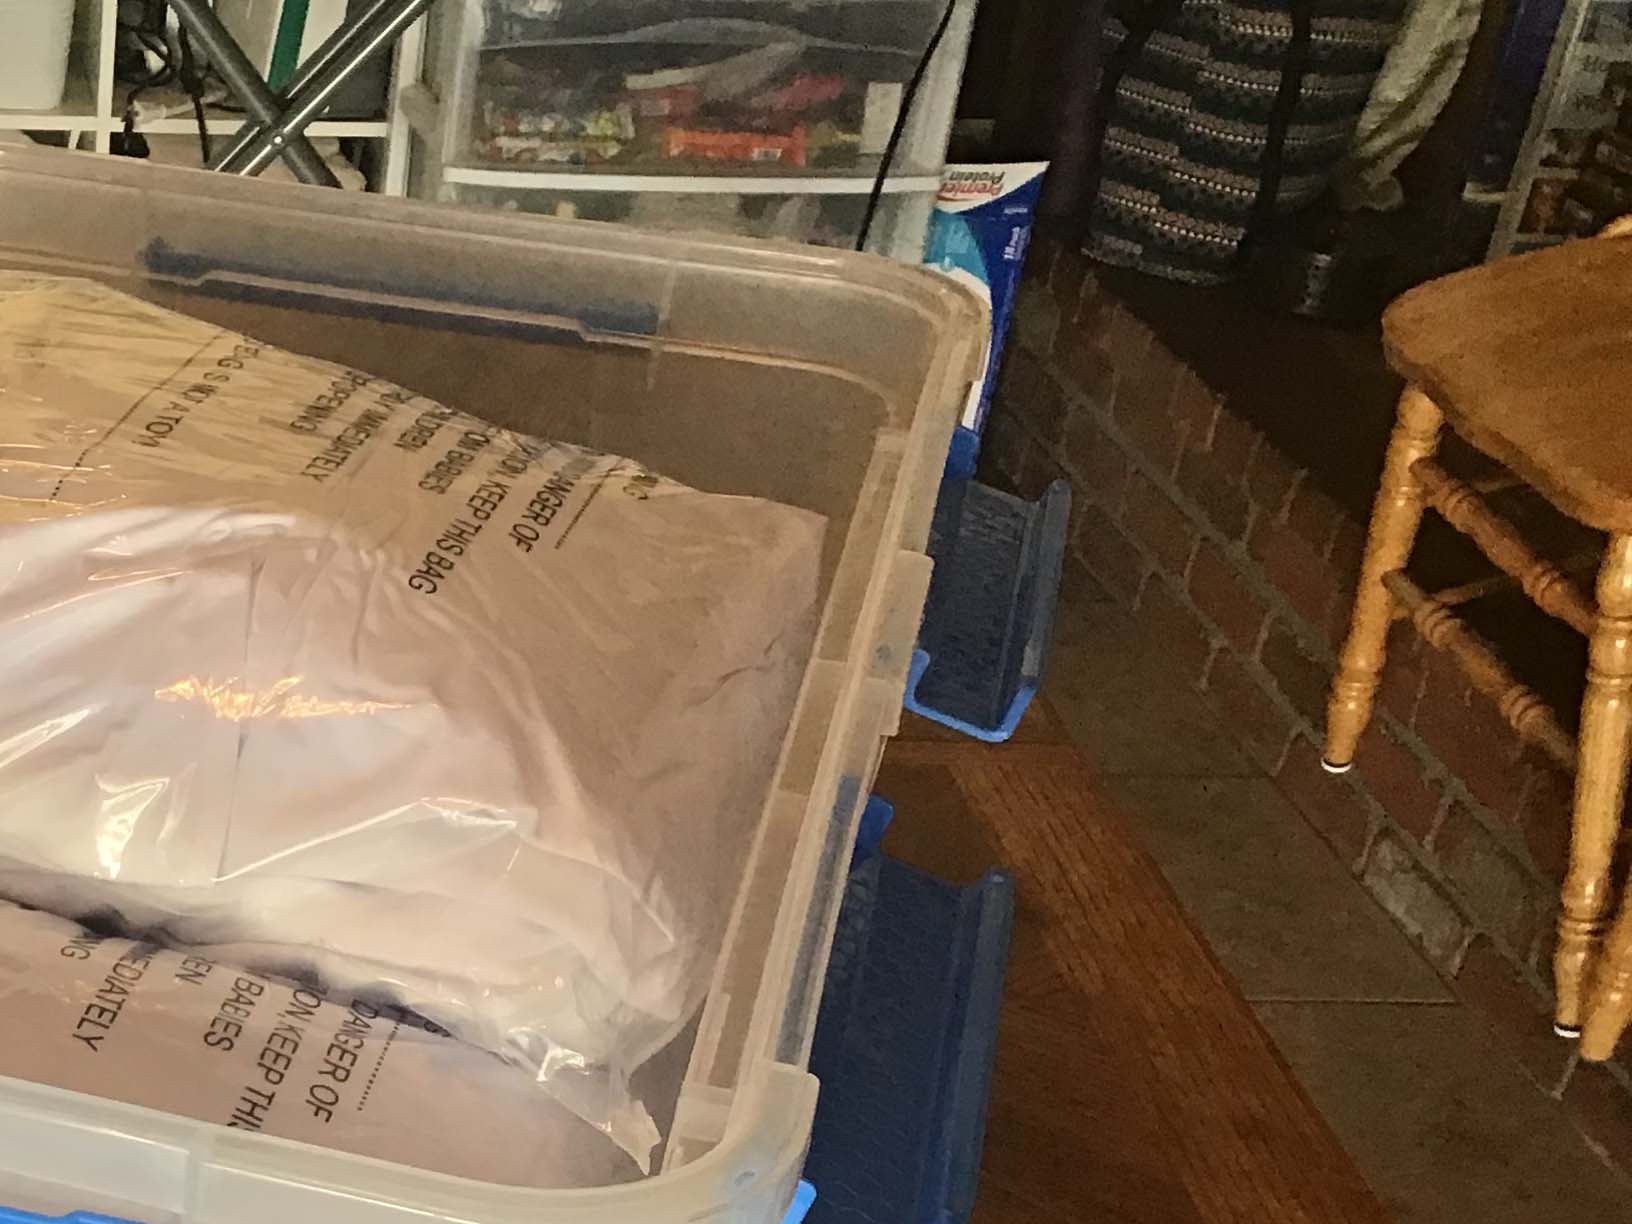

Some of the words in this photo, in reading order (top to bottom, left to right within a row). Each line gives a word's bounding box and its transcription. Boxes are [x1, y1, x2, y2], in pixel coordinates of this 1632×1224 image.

[466, 480, 511, 522] KEEP
[436, 518, 483, 557] THIS
[509, 523, 540, 553] OF
[408, 551, 455, 594] BAG
[203, 977, 265, 1052] BABIES
[256, 1020, 307, 1086] KEEP
[318, 999, 378, 1083] DANGER
[305, 1083, 340, 1123] OF
